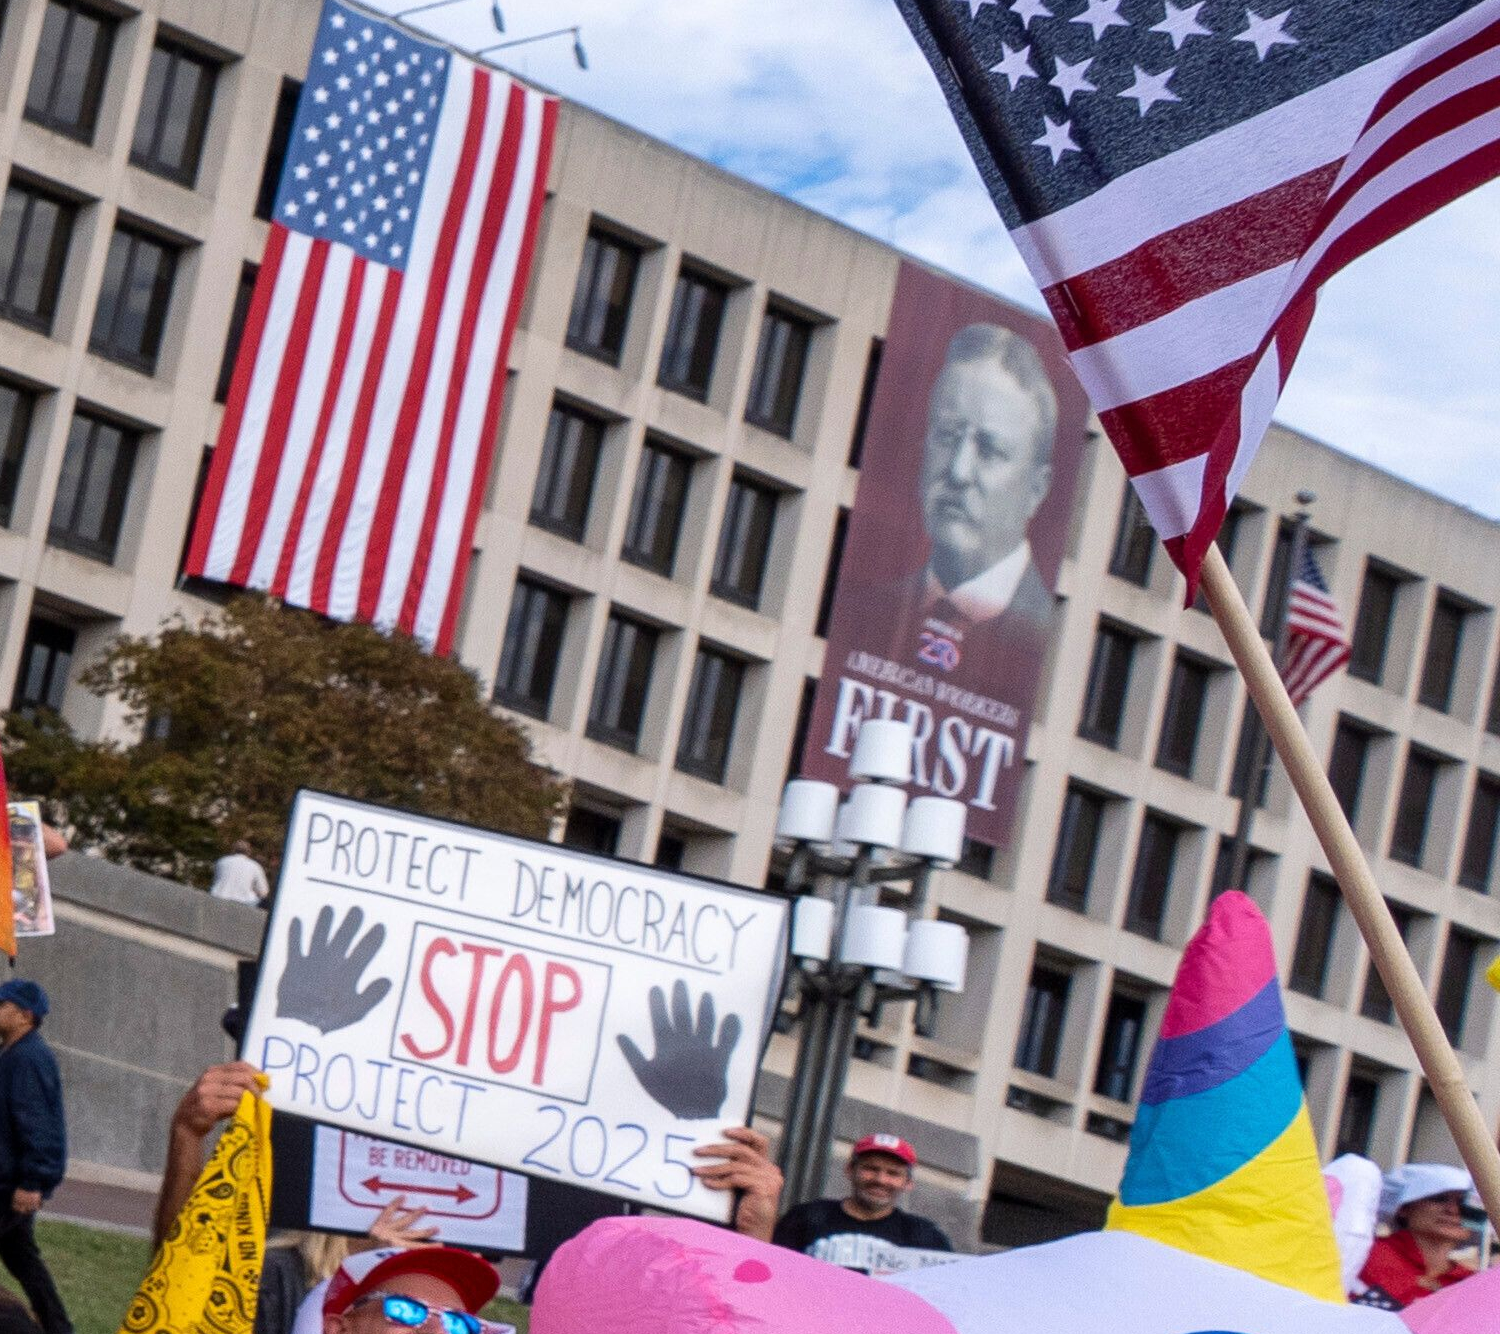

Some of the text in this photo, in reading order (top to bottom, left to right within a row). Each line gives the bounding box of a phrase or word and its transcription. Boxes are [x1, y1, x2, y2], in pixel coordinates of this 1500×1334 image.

[825, 675, 1017, 812] FRST
[302, 812, 758, 970] PROTECT DEMOCRACY
[400, 936, 583, 1087] STOP
[260, 1036, 700, 1199] PROJECT 2025
[368, 1146, 472, 1176] BE REMOVED
[239, 1240, 258, 1261] NO
